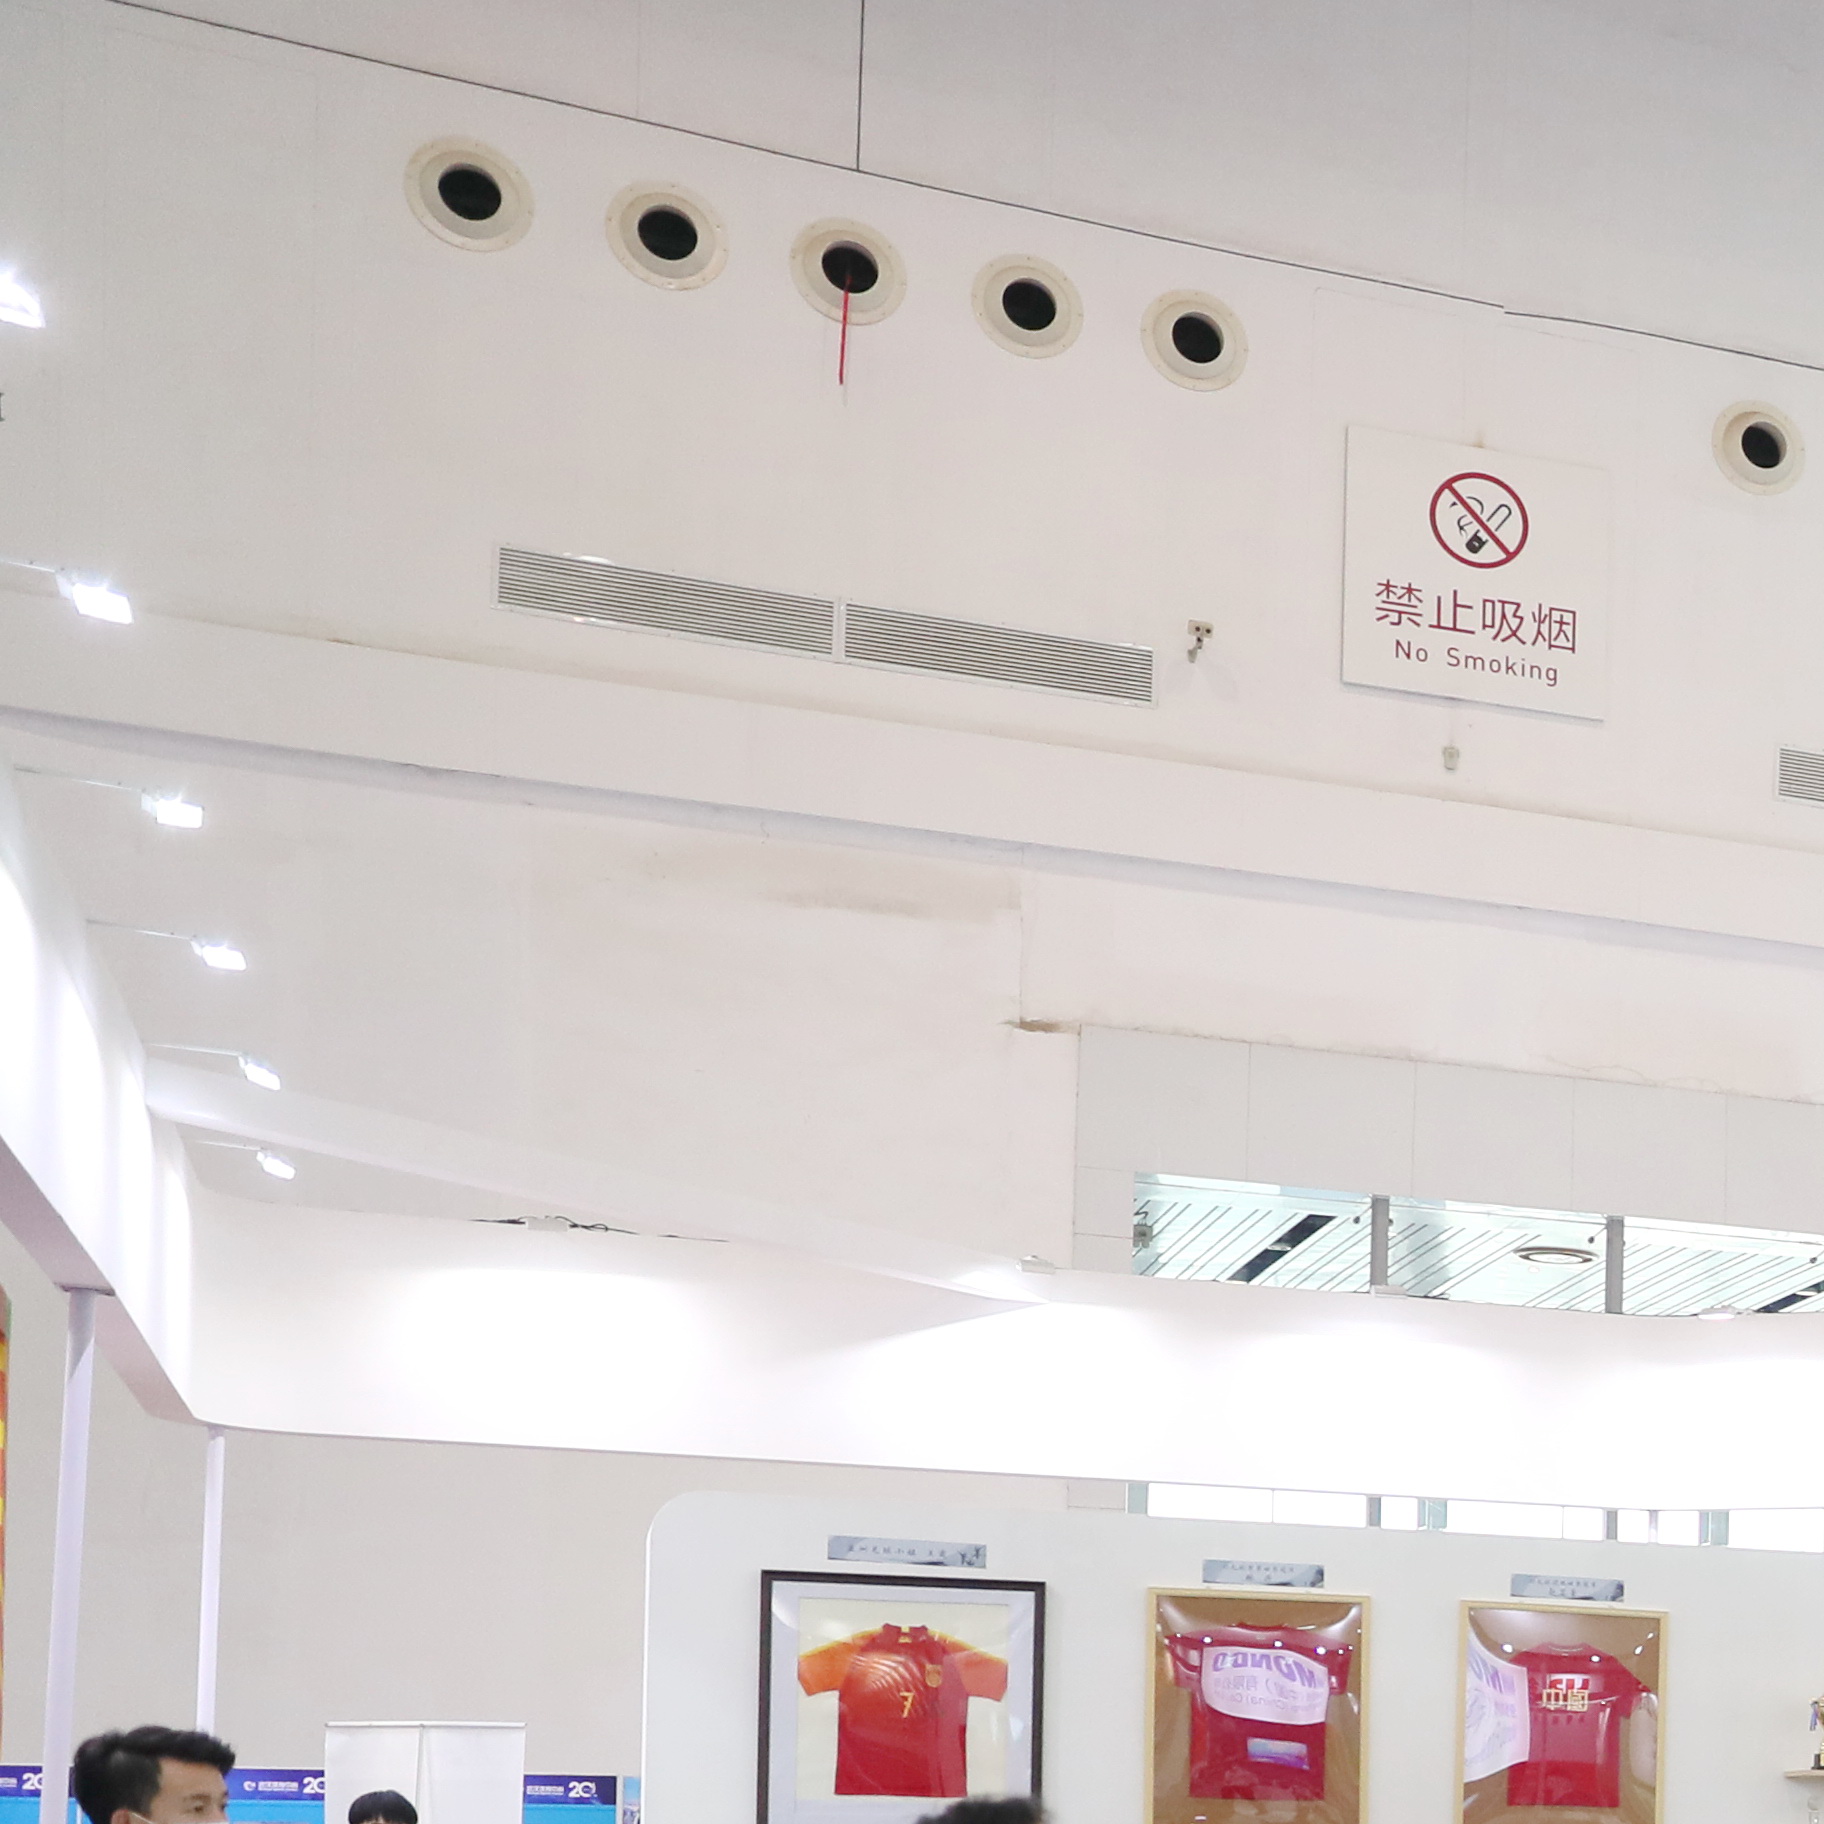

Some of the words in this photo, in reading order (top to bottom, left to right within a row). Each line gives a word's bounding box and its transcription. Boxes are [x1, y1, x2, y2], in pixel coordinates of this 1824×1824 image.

[1374, 578, 1577, 655] 禁止吸烟
[1394, 638, 1429, 663] No
[1446, 647, 1559, 688] Smoking
[899, 1692, 915, 1719] 7
